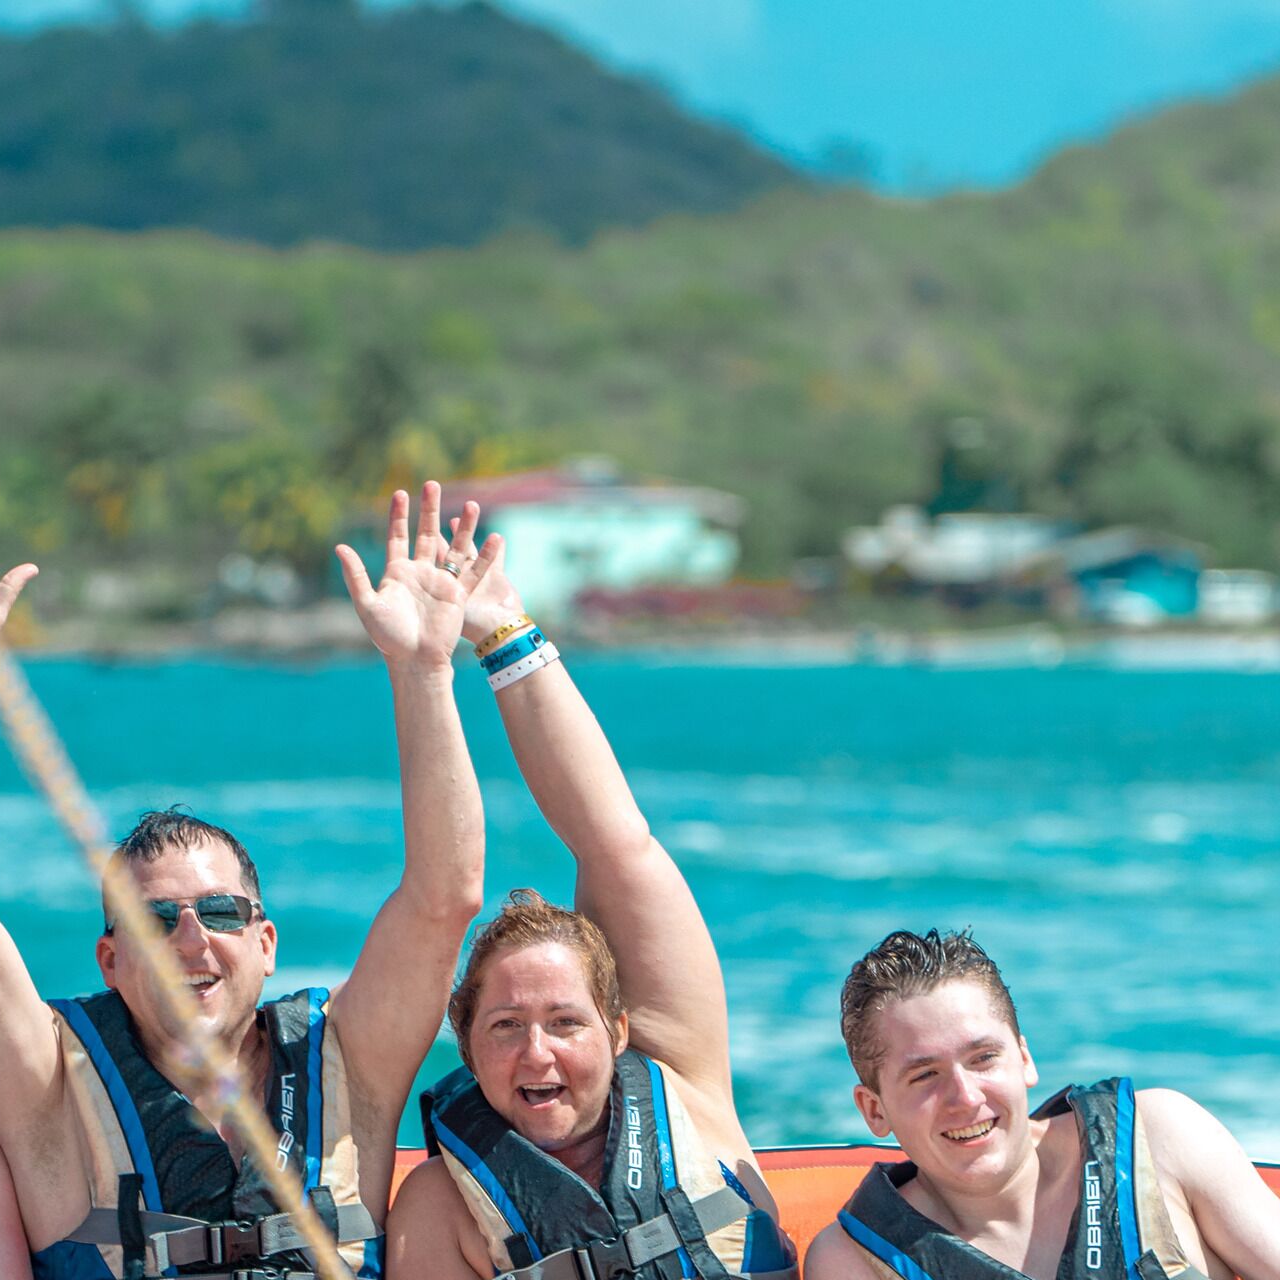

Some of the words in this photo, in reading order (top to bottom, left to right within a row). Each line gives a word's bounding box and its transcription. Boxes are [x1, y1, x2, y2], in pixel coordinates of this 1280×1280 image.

[275, 1073, 296, 1172] OBRIEN
[624, 1095, 643, 1190] OBRIEN
[1085, 1160, 1102, 1269] OBRIEN
